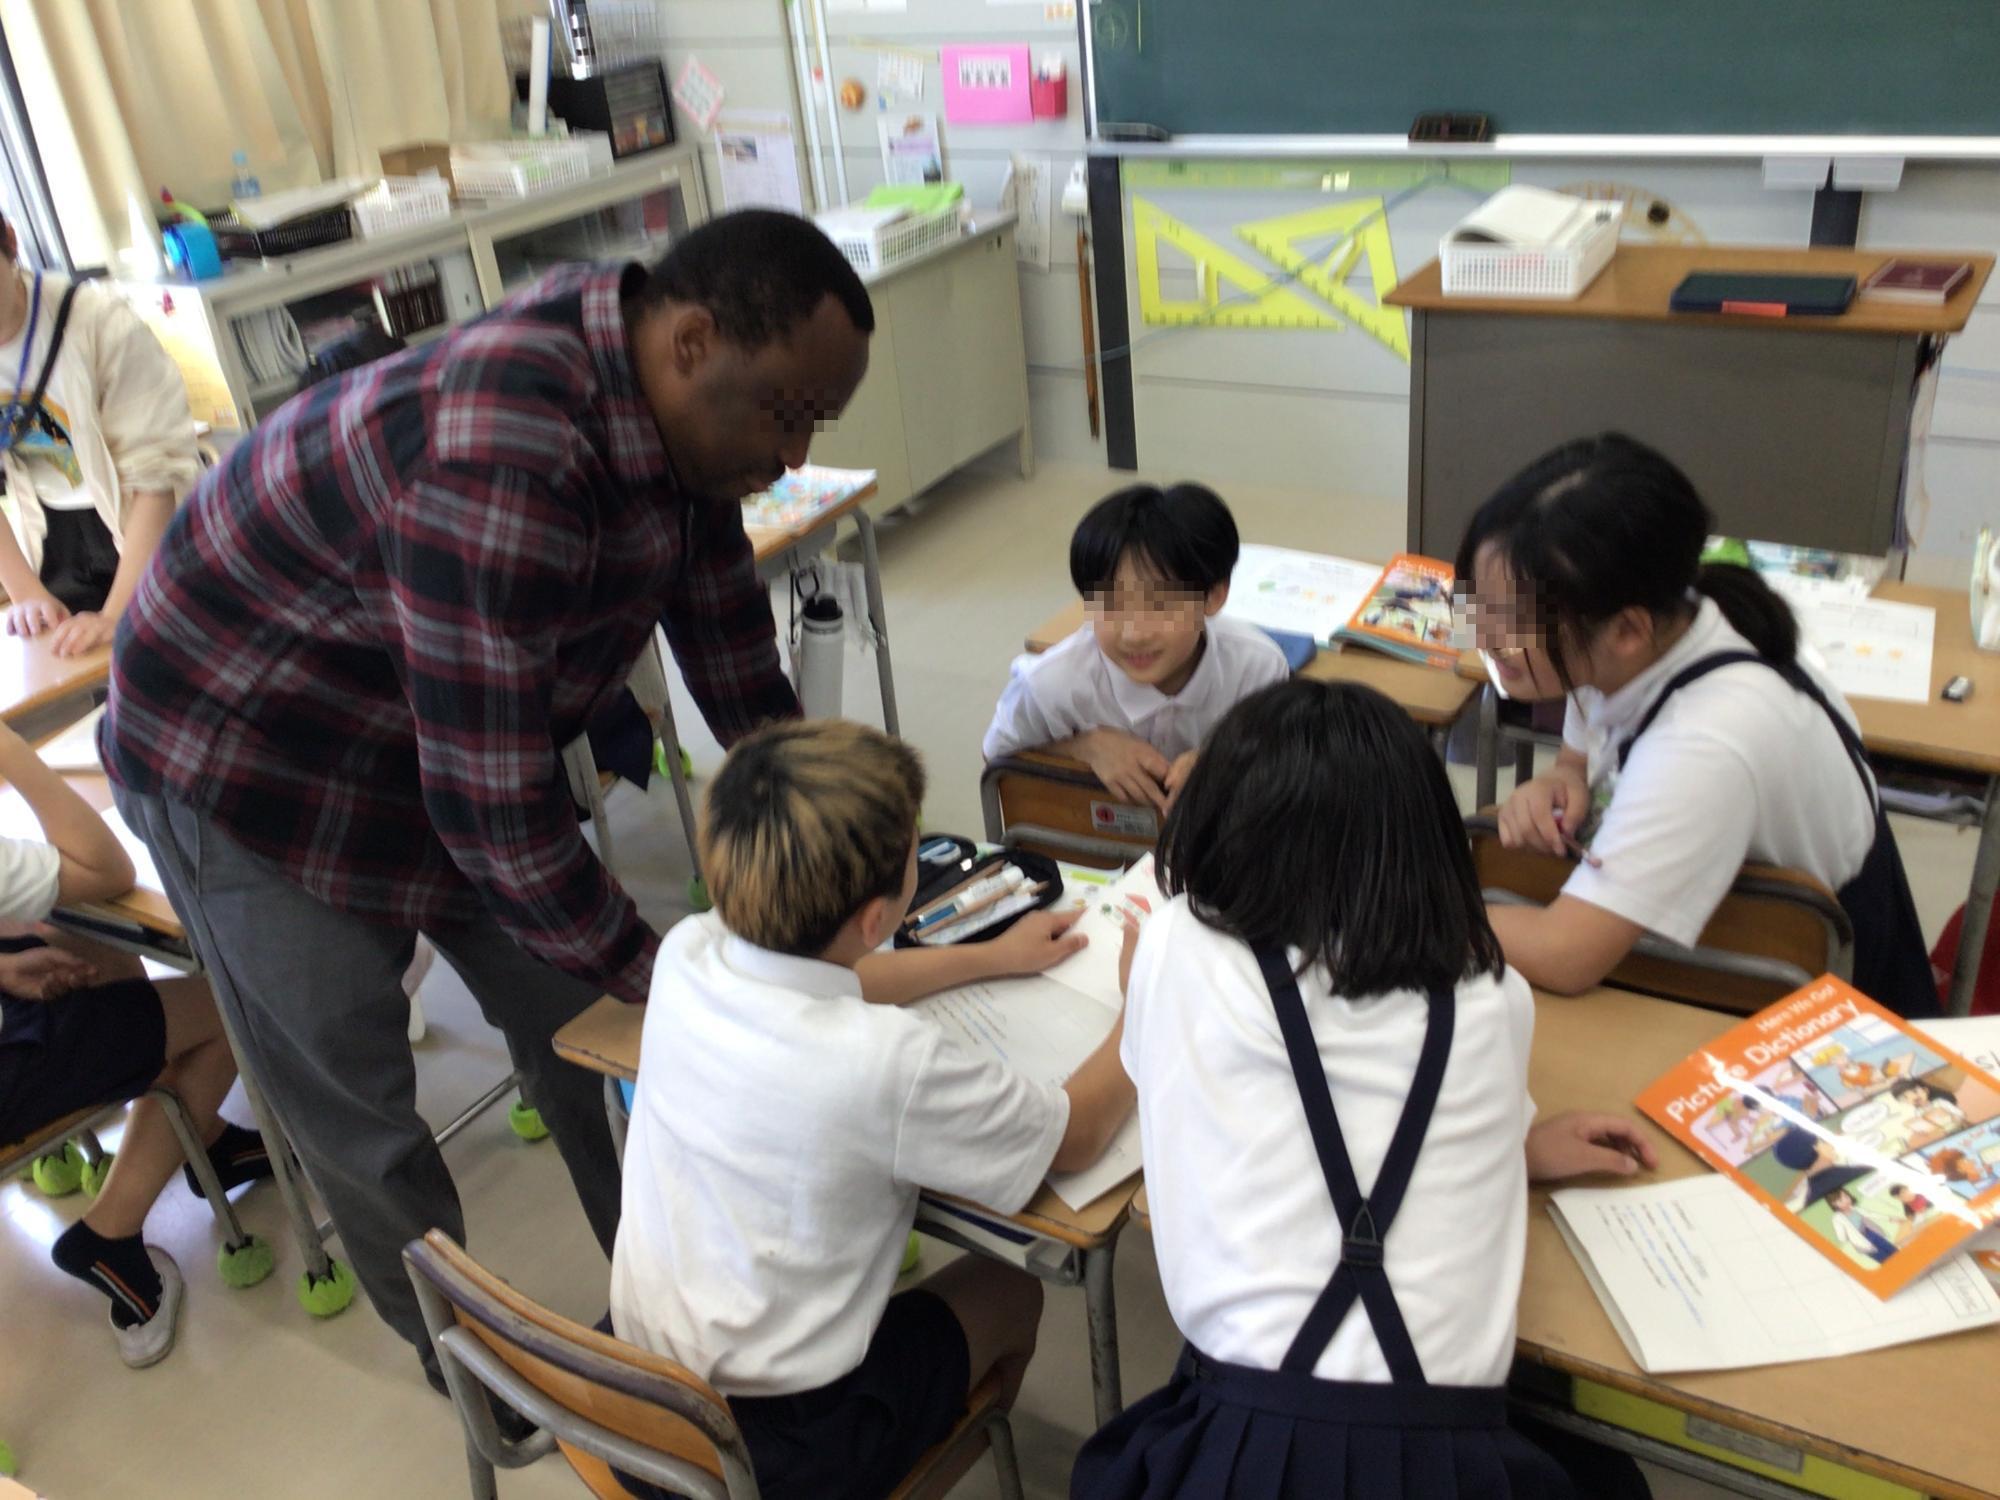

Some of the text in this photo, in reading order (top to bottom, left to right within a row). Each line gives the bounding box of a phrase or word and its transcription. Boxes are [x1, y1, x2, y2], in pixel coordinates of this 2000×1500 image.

[1755, 1010, 1794, 1033] Here
[1665, 998, 1860, 1124] Pictue Dictionary
